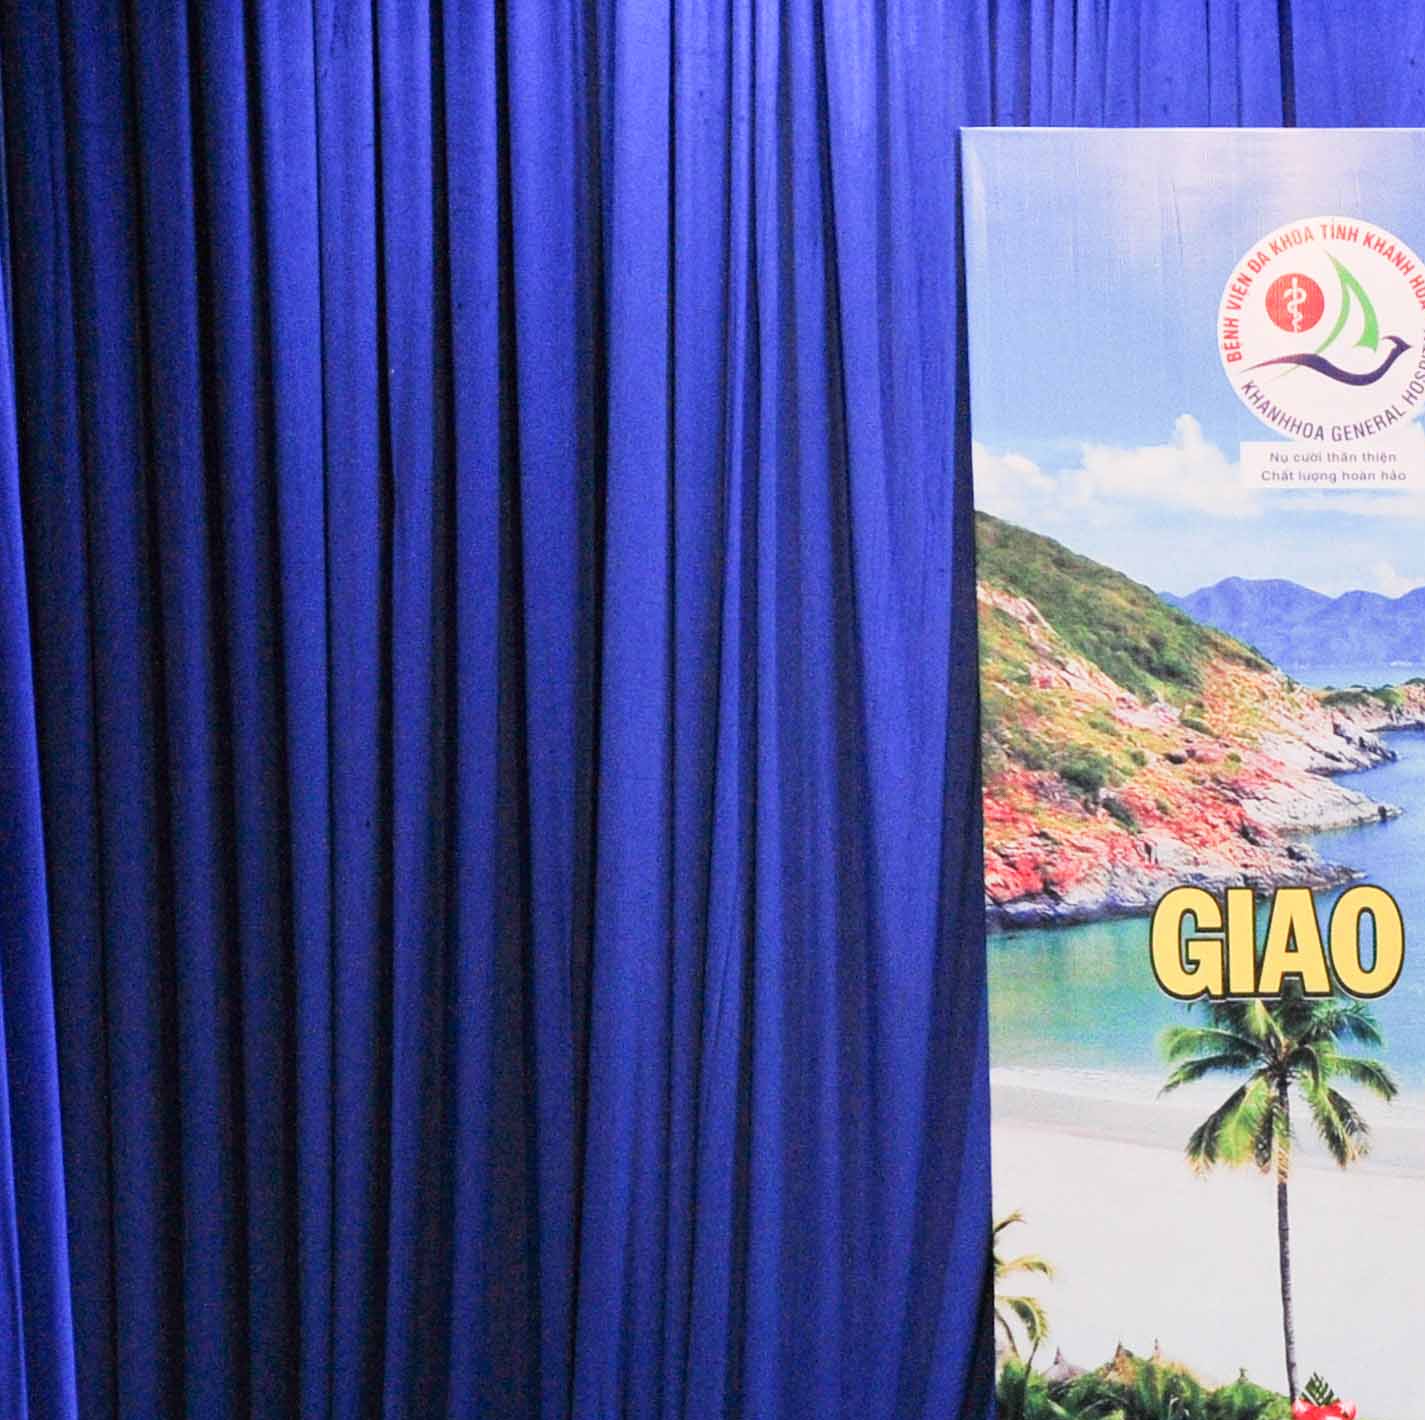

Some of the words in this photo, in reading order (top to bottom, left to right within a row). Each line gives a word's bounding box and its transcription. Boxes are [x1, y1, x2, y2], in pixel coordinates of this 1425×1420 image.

[1270, 227, 1315, 255] KHOA
[1241, 379, 1325, 440] KHANHHOA
[1331, 405, 1407, 442] GENERAL
[1150, 881, 1406, 998] GIAO
